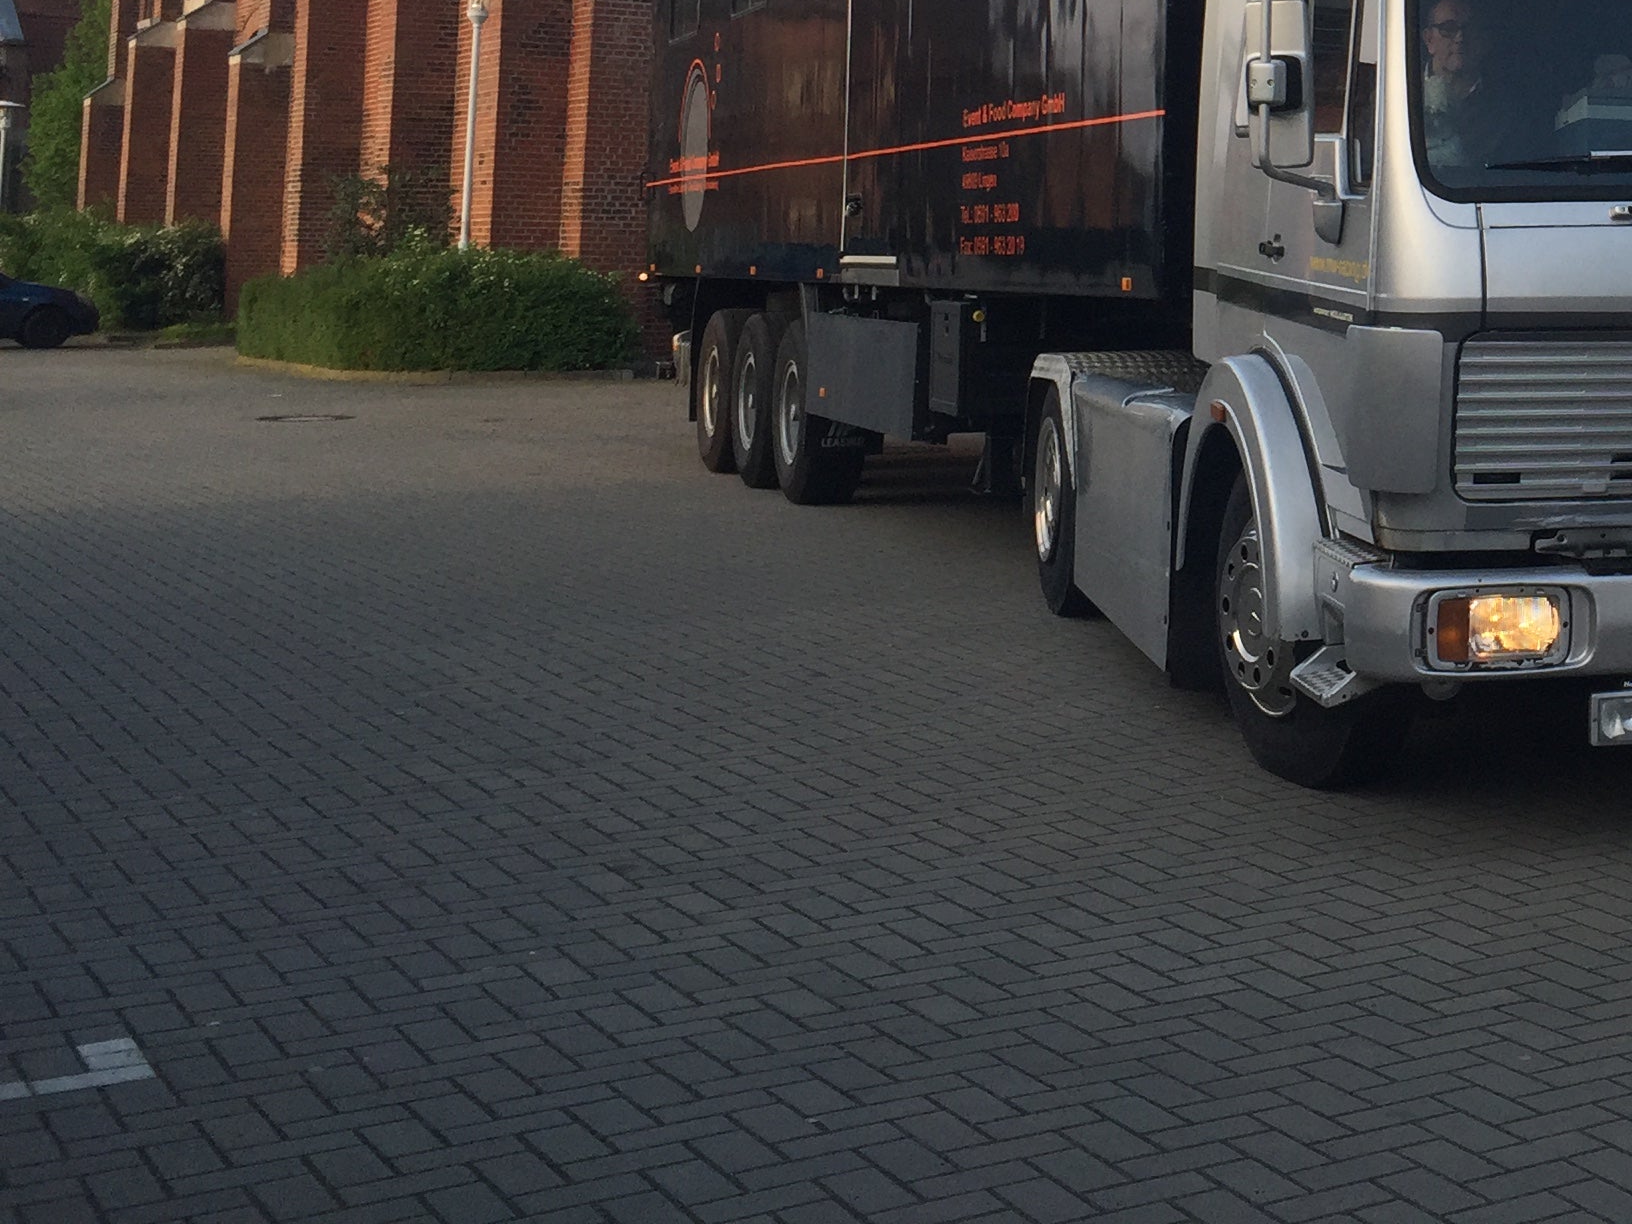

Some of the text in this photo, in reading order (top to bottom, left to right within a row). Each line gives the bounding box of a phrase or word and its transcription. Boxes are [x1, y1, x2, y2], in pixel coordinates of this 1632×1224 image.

[963, 109, 981, 129] Event
[988, 103, 1006, 123] Food
[1007, 99, 1041, 122] Company
[1042, 92, 1066, 115] GmbH
